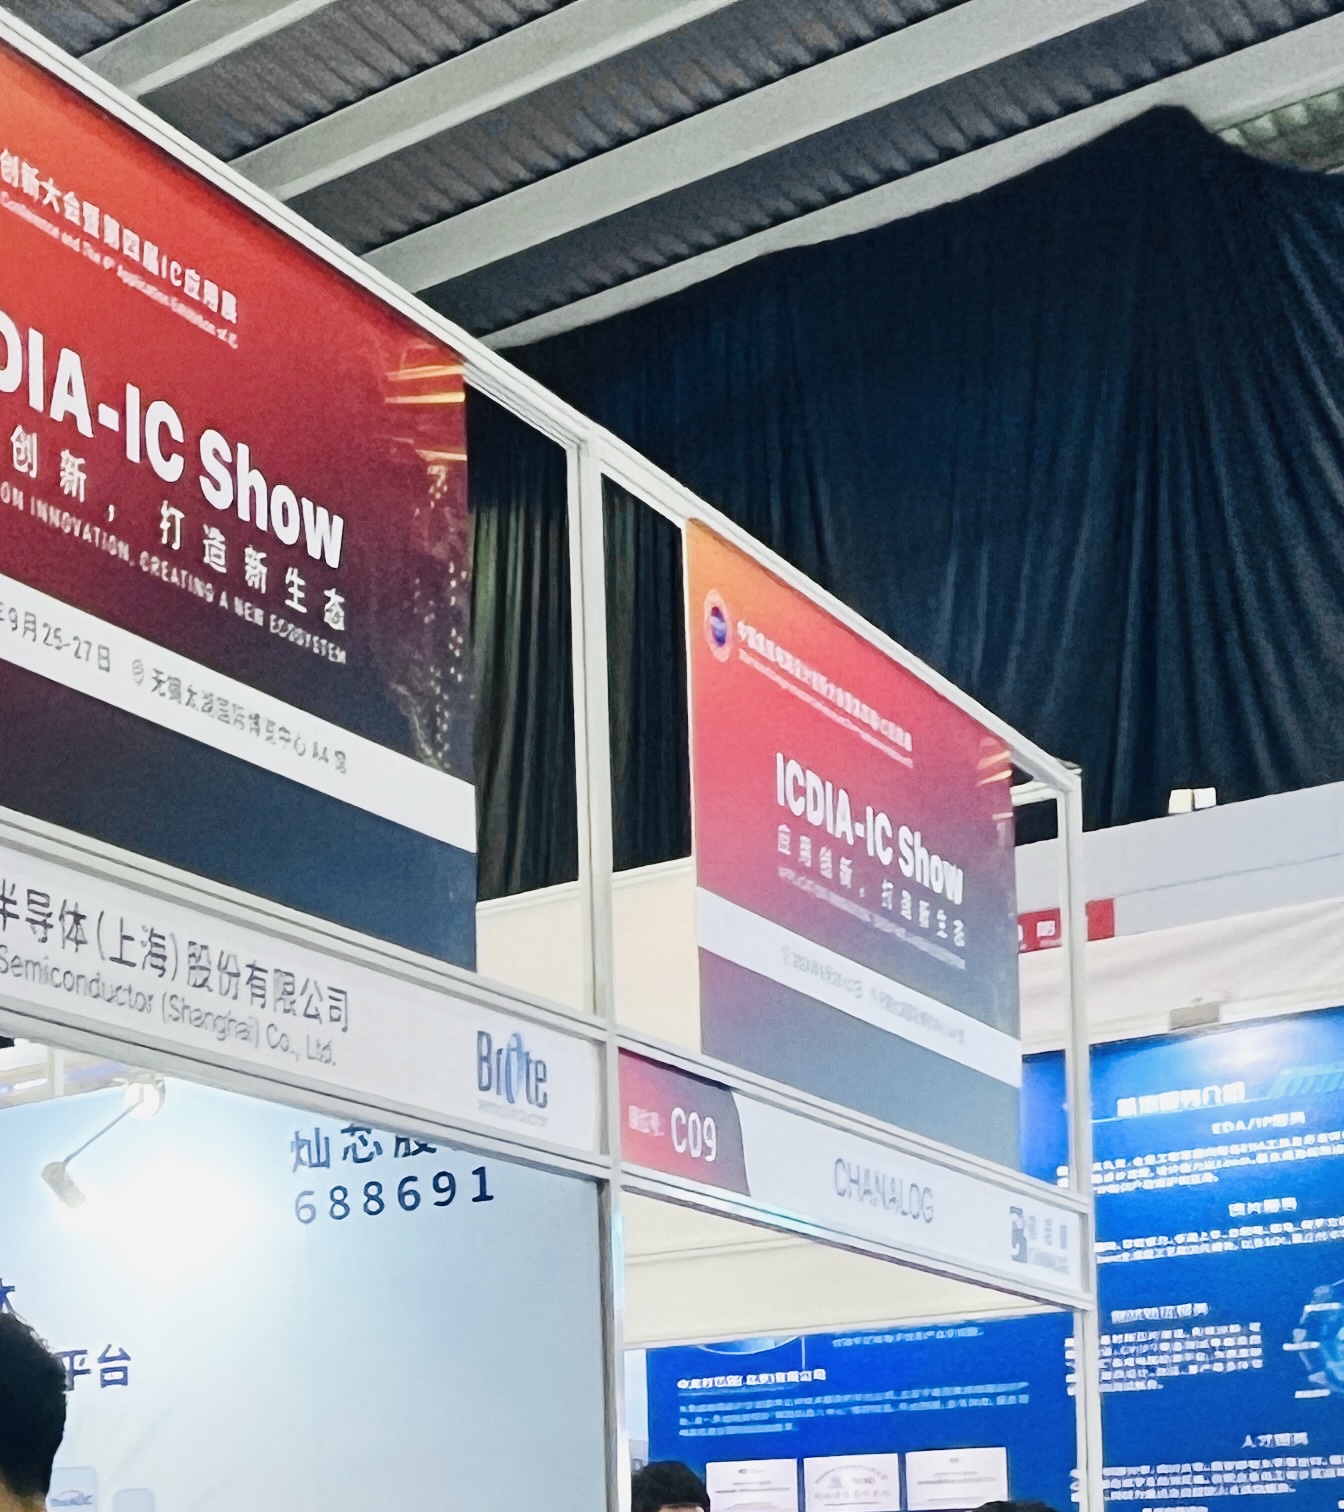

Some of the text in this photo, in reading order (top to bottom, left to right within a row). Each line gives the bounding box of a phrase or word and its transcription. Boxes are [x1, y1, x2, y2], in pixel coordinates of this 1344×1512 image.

[199, 428, 344, 569] Show
[776, 752, 964, 905] ICDIA-IC Show
[670, 1107, 716, 1162] C09
[295, 1166, 494, 1225] 688691
